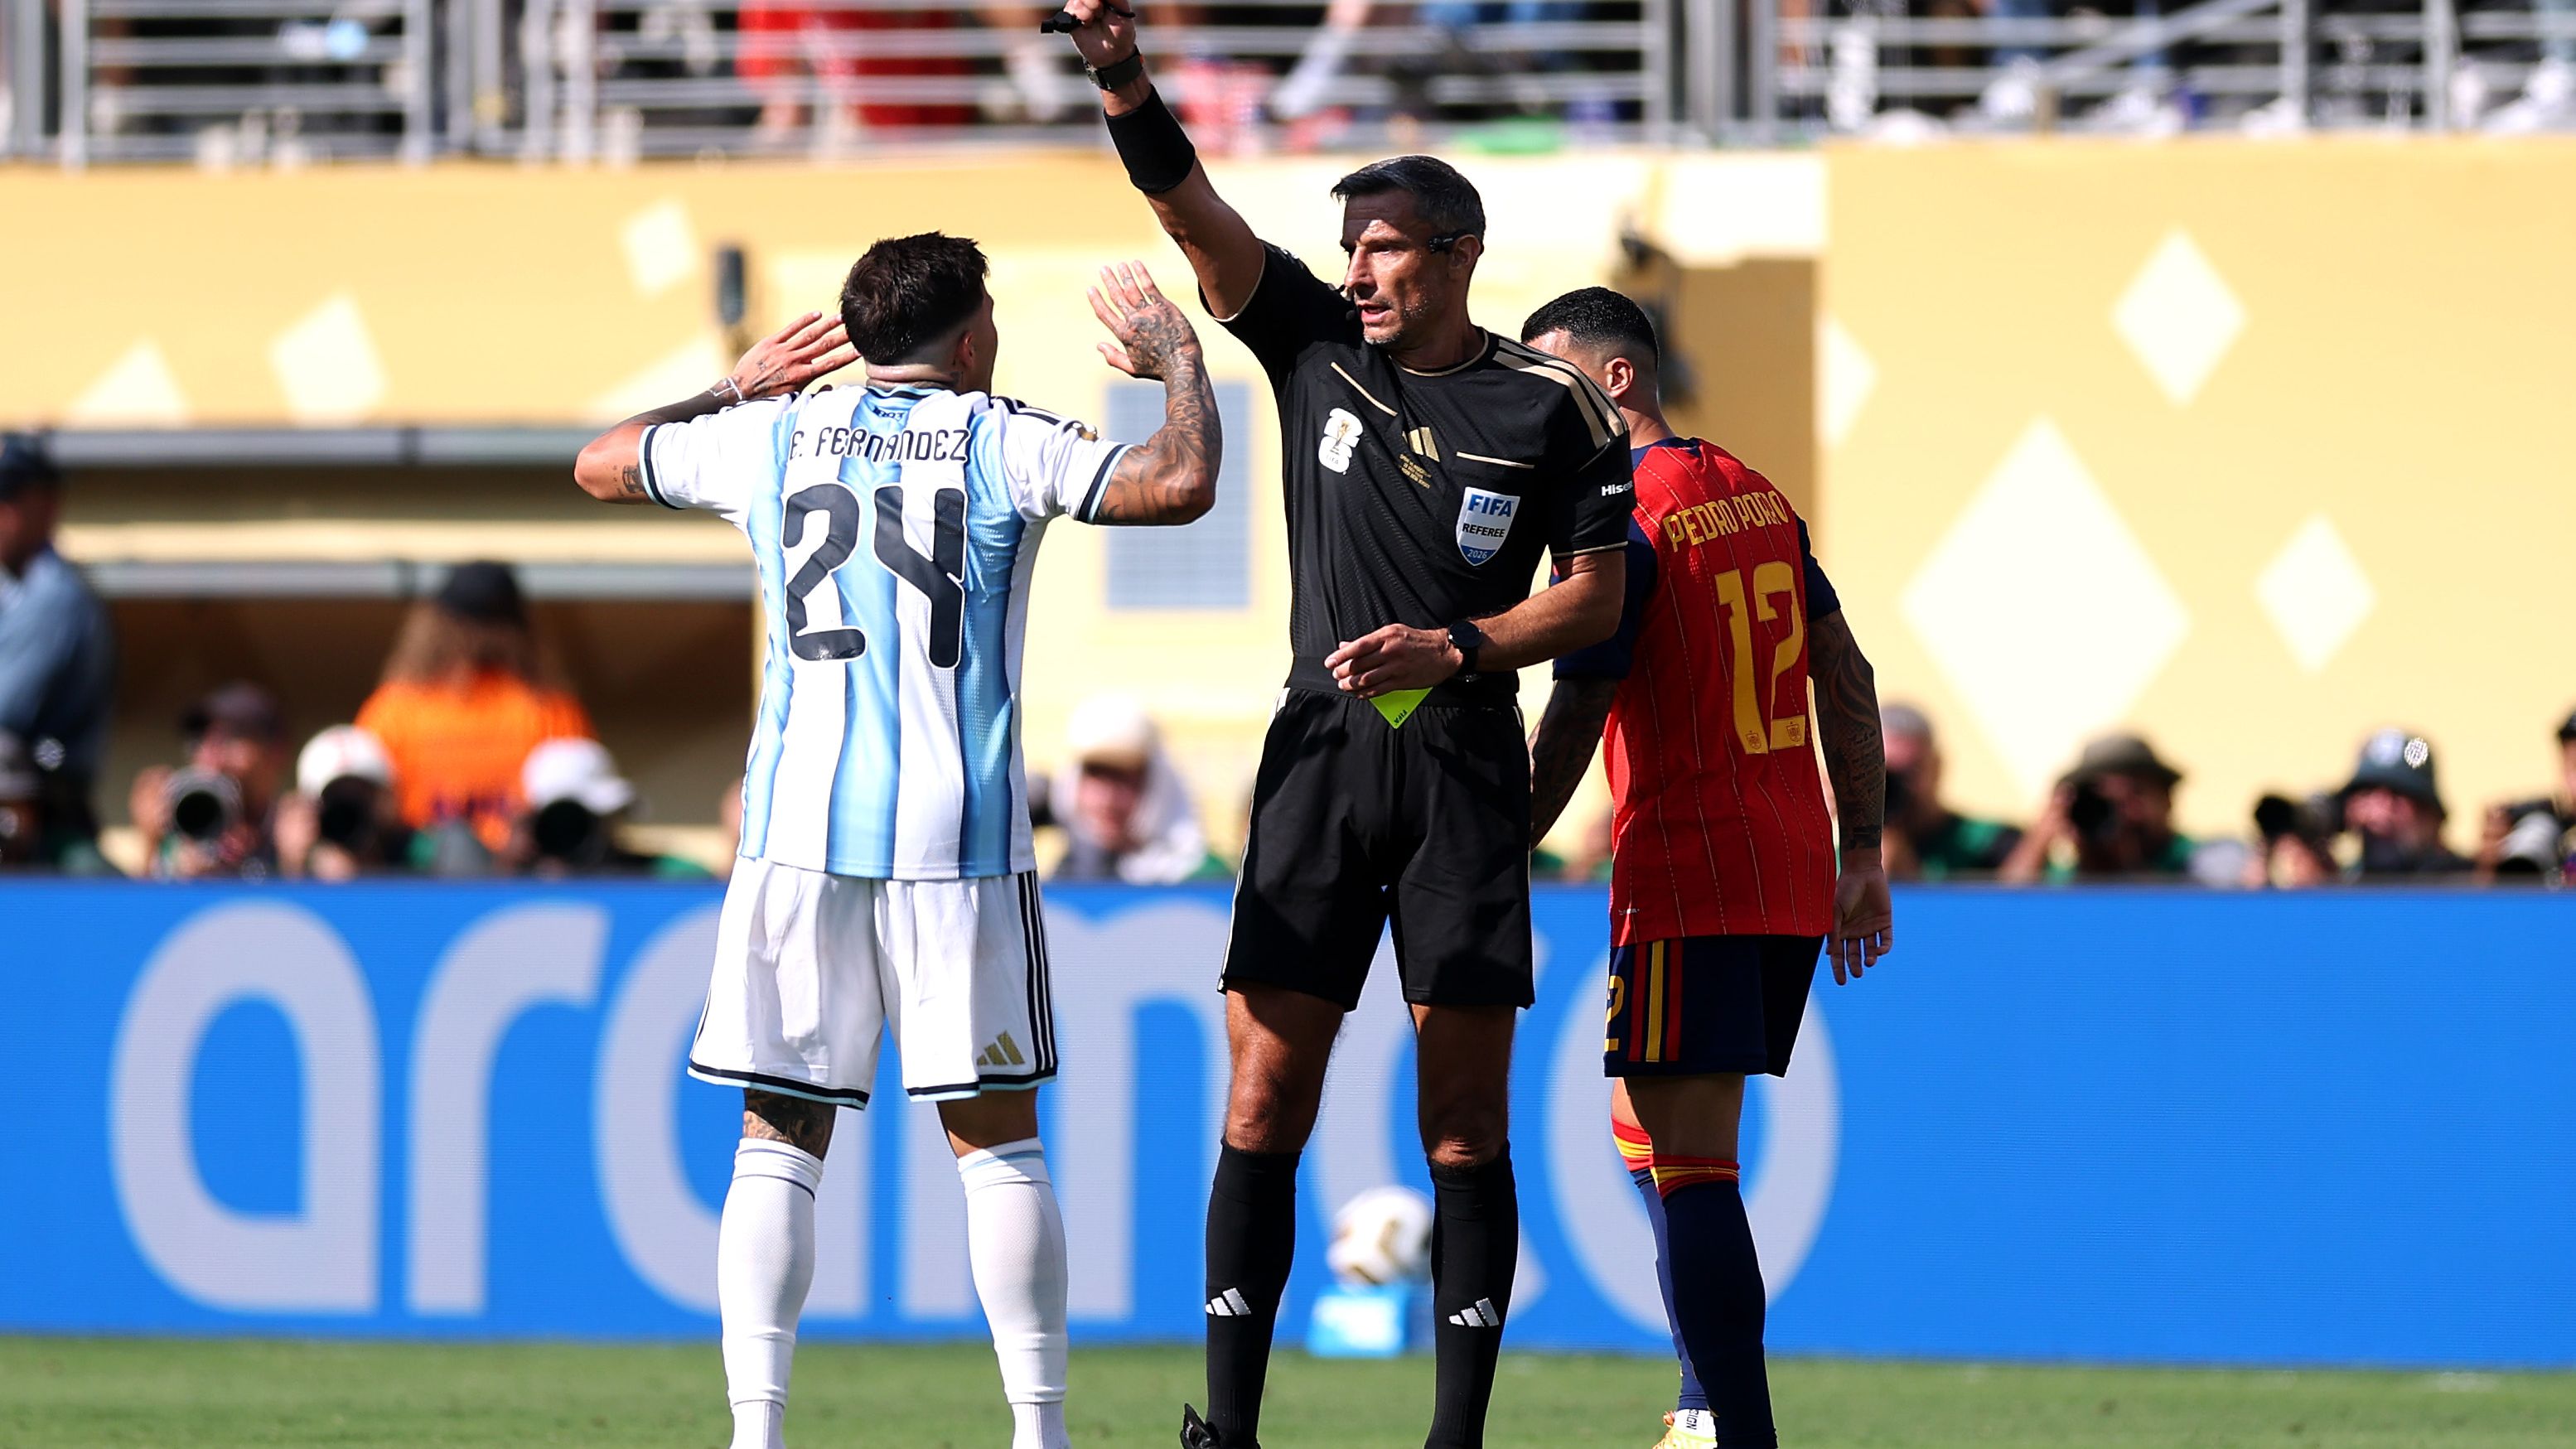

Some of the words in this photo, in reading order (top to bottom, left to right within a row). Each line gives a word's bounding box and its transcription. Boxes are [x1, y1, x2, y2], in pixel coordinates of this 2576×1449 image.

[790, 430, 803, 461] E.
[815, 427, 969, 462] FERNANDEZ
[1467, 494, 1512, 517] FIFA
[1663, 499, 1739, 553] PEDRO
[1732, 490, 1789, 530] PORRO
[1462, 523, 1505, 538] REFEREE
[1467, 548, 1487, 559] 2026
[783, 482, 967, 669] 24
[1714, 561, 1805, 755] 12
